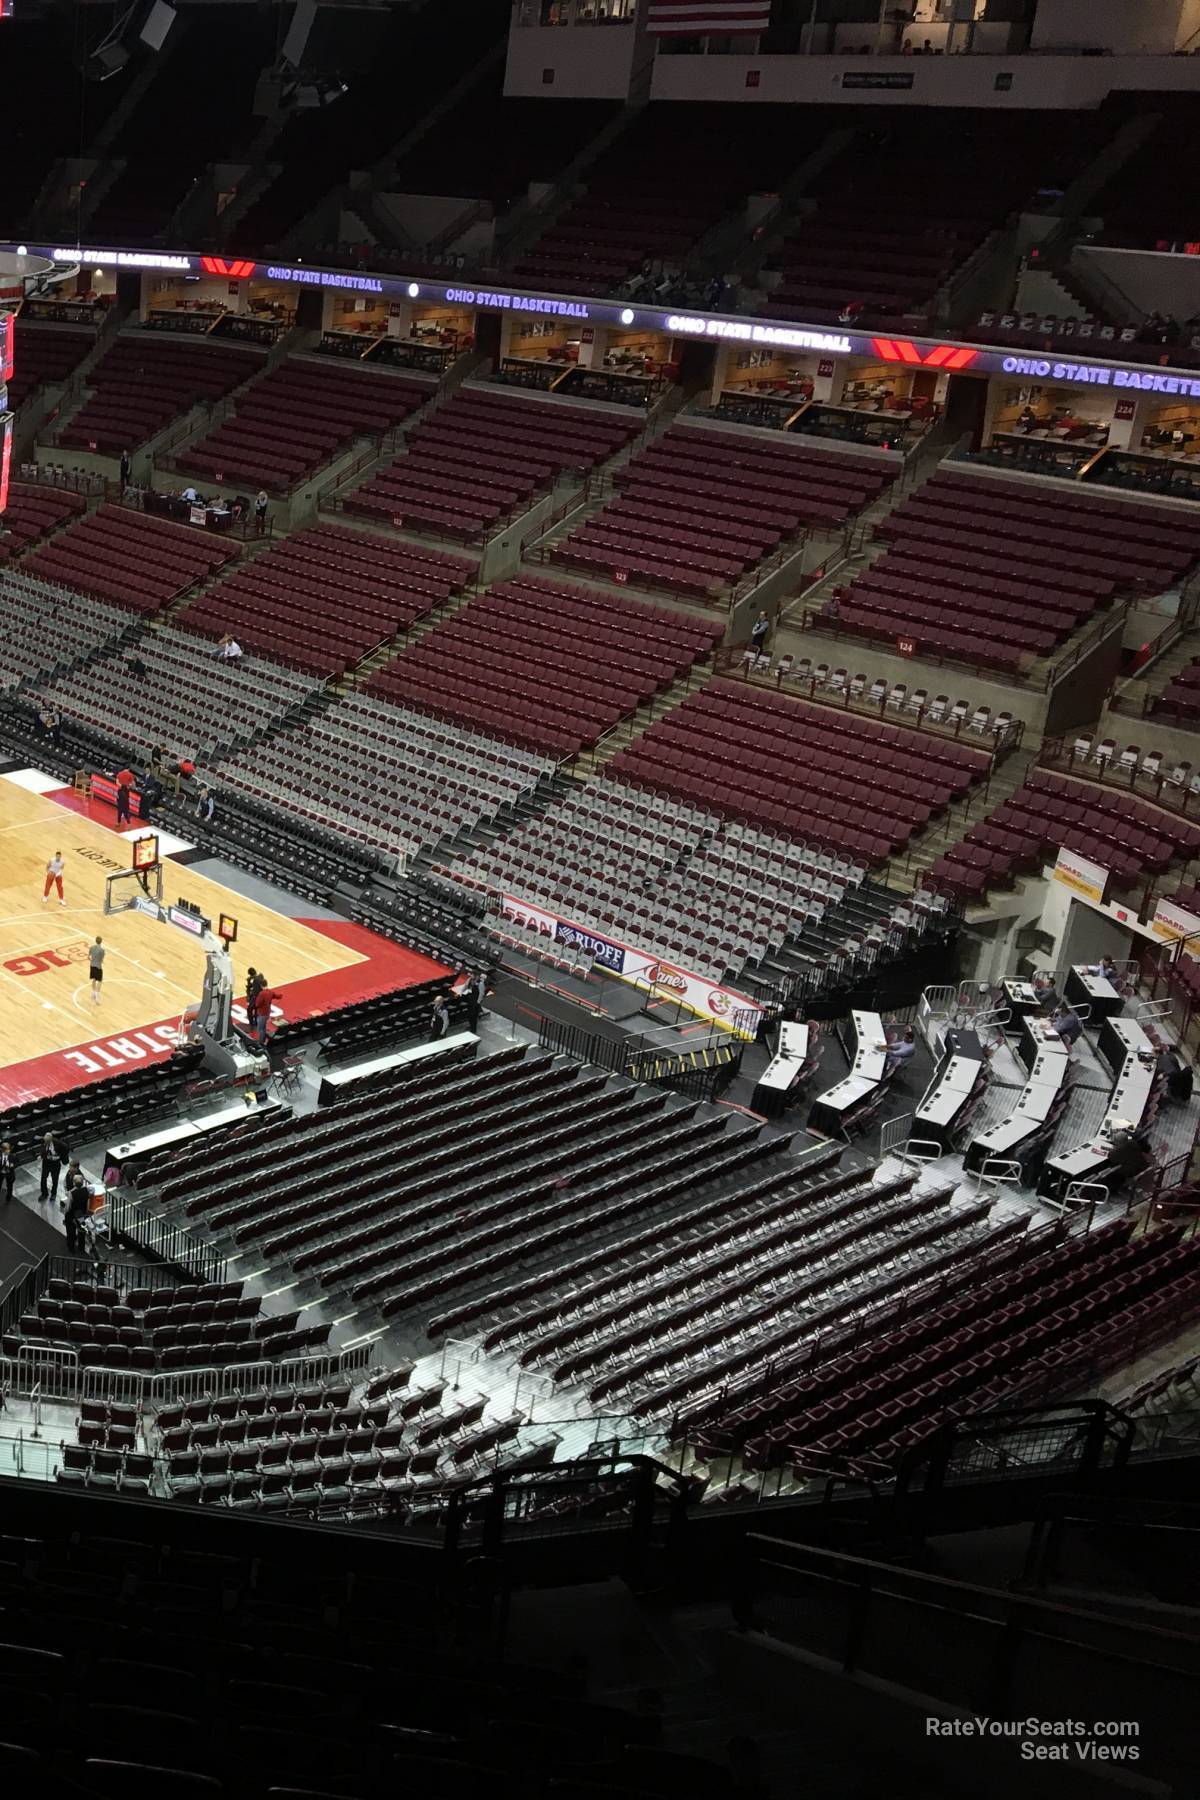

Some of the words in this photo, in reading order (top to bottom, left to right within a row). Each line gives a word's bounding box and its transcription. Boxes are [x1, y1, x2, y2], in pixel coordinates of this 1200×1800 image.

[54, 248, 82, 261] OHIO
[83, 250, 117, 264] STATE
[118, 252, 190, 269] BASKETBALL
[267, 267, 292, 280] OHIO
[293, 269, 320, 285] STATE
[321, 272, 383, 293] BASKETBALL
[446, 288, 475, 304] OHIO
[476, 291, 511, 308] STATE
[513, 296, 589, 318] BASKETBALL
[668, 315, 705, 333] OHIO
[707, 319, 752, 340] STATE
[753, 325, 852, 352] BASKETBALL
[1003, 357, 1050, 376] OHIO
[1052, 362, 1111, 385] STATE
[899, 642, 912, 652] 124
[71, 848, 104, 860] CITY
[575, 931, 623, 963] RUOFF
[64, 1025, 188, 1074] STATE
